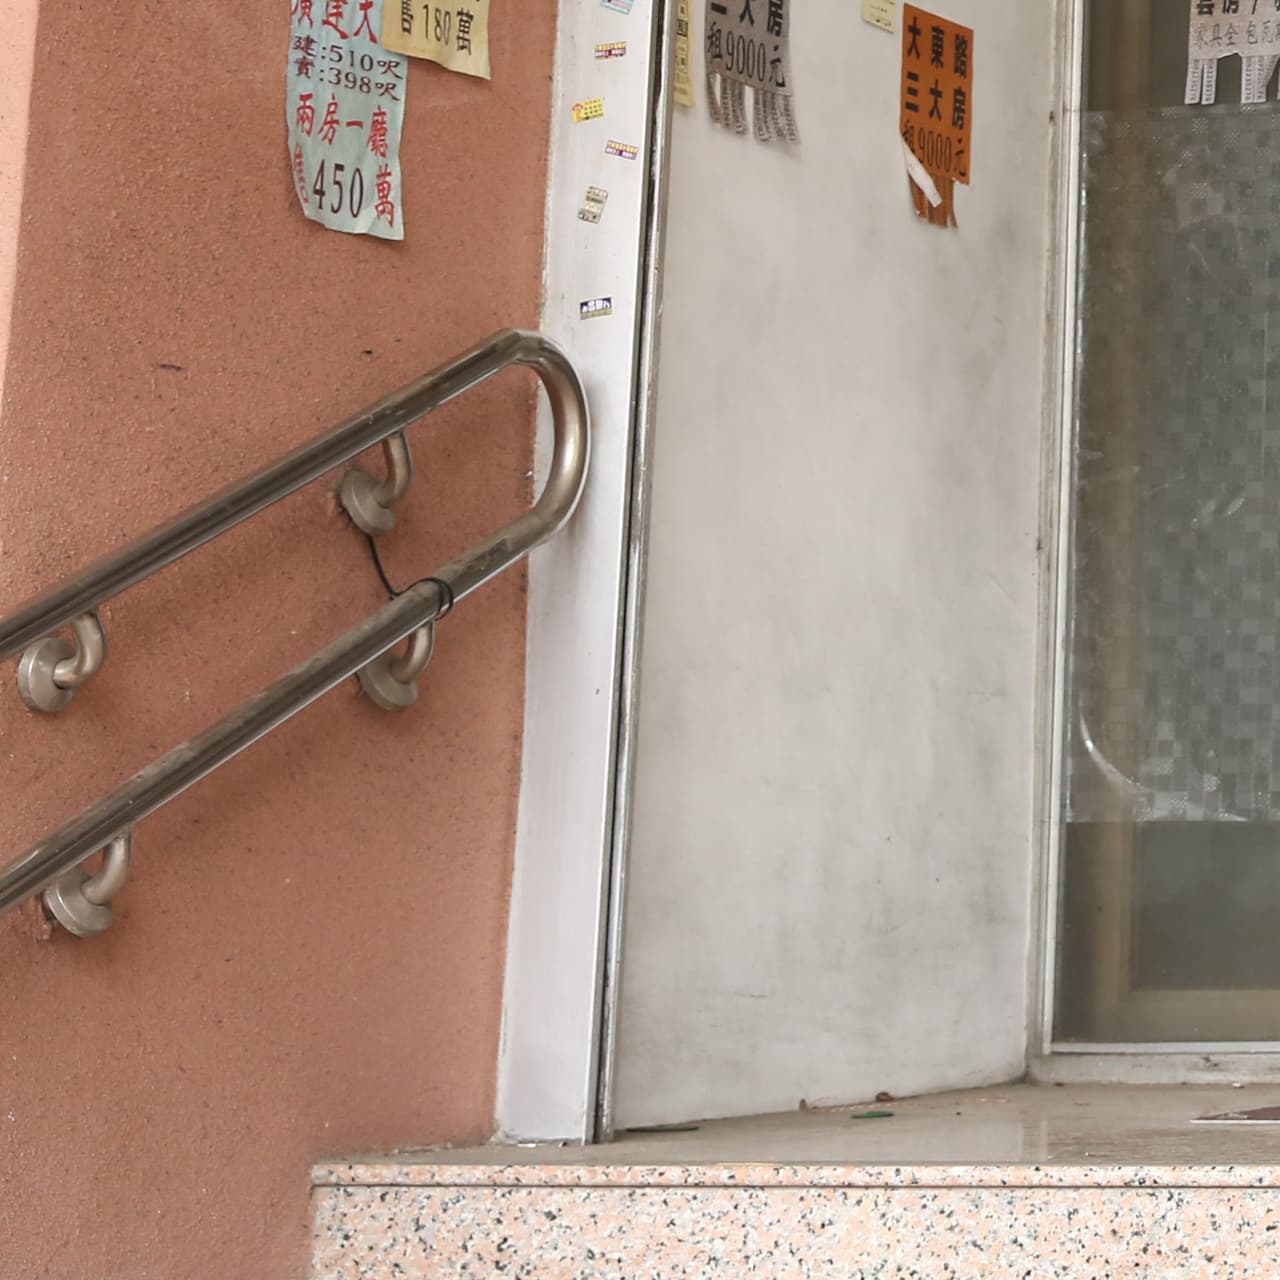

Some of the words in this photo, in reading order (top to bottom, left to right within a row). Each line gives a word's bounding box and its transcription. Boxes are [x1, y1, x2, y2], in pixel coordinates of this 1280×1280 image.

[707, 21, 787, 89] 租9000元
[907, 16, 967, 80] 大東路
[295, 92, 389, 159] 兩房一廳
[904, 71, 967, 131] 三大房
